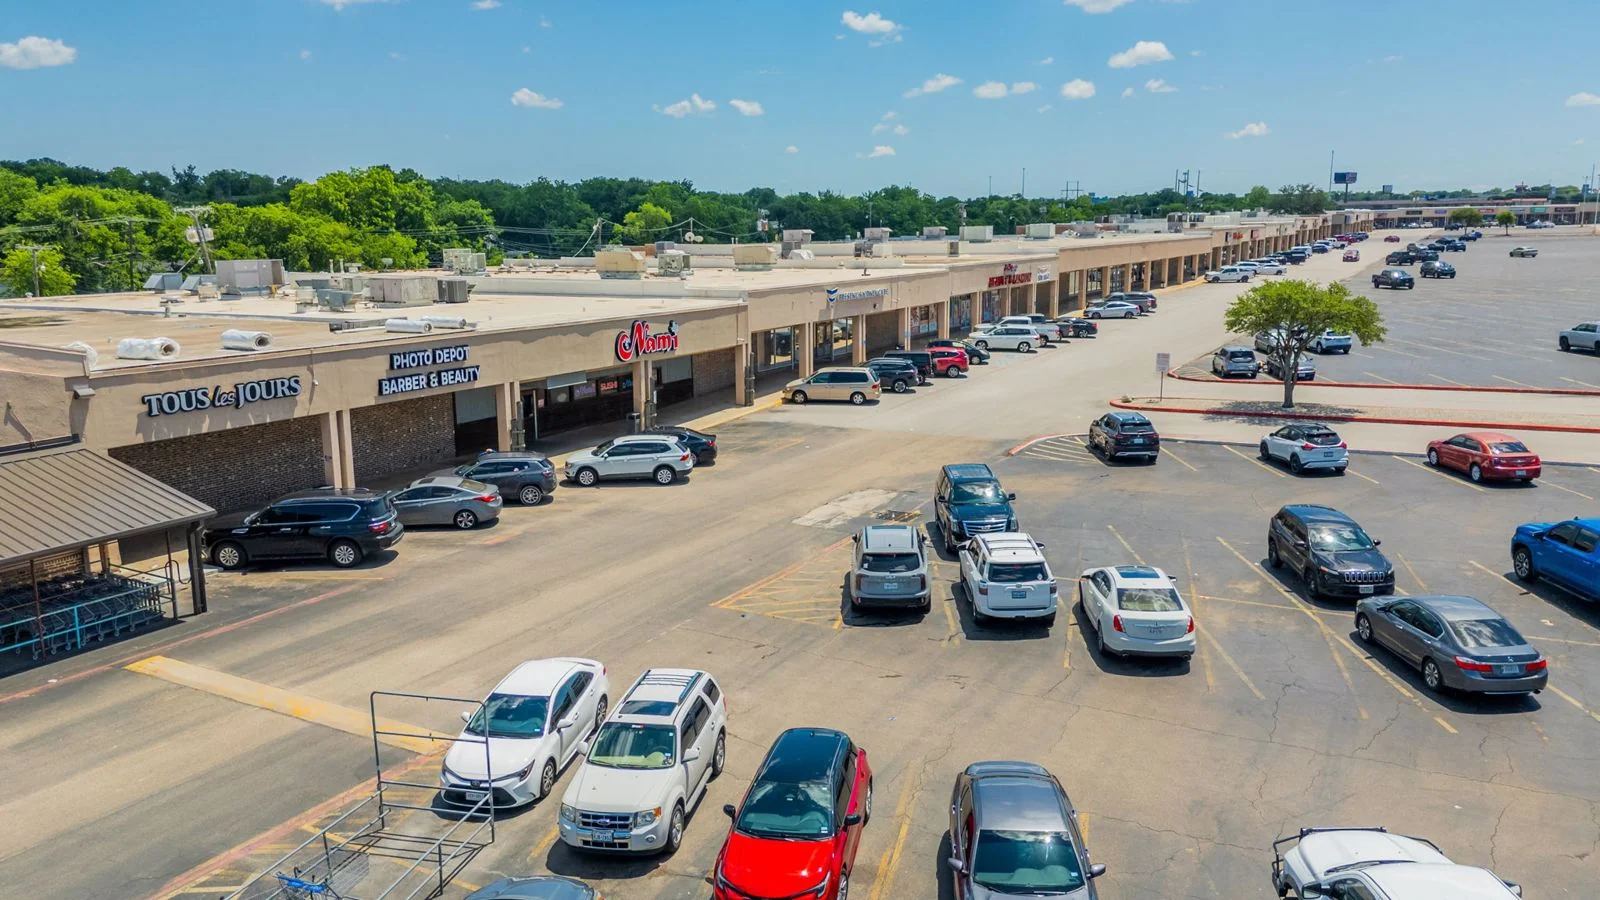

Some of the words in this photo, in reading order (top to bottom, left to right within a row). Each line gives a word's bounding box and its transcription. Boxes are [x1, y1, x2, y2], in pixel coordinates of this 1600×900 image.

[616, 320, 680, 361] Nami
[392, 350, 433, 369] PHOTO
[435, 346, 470, 364] DEPOT
[381, 375, 427, 395] BARBER
[429, 373, 438, 388] &
[441, 366, 480, 385] BEAUTY
[600, 381, 618, 391] SUSHI
[144, 388, 211, 416] TOUS
[214, 385, 236, 406] les
[236, 376, 302, 408] JOURS
